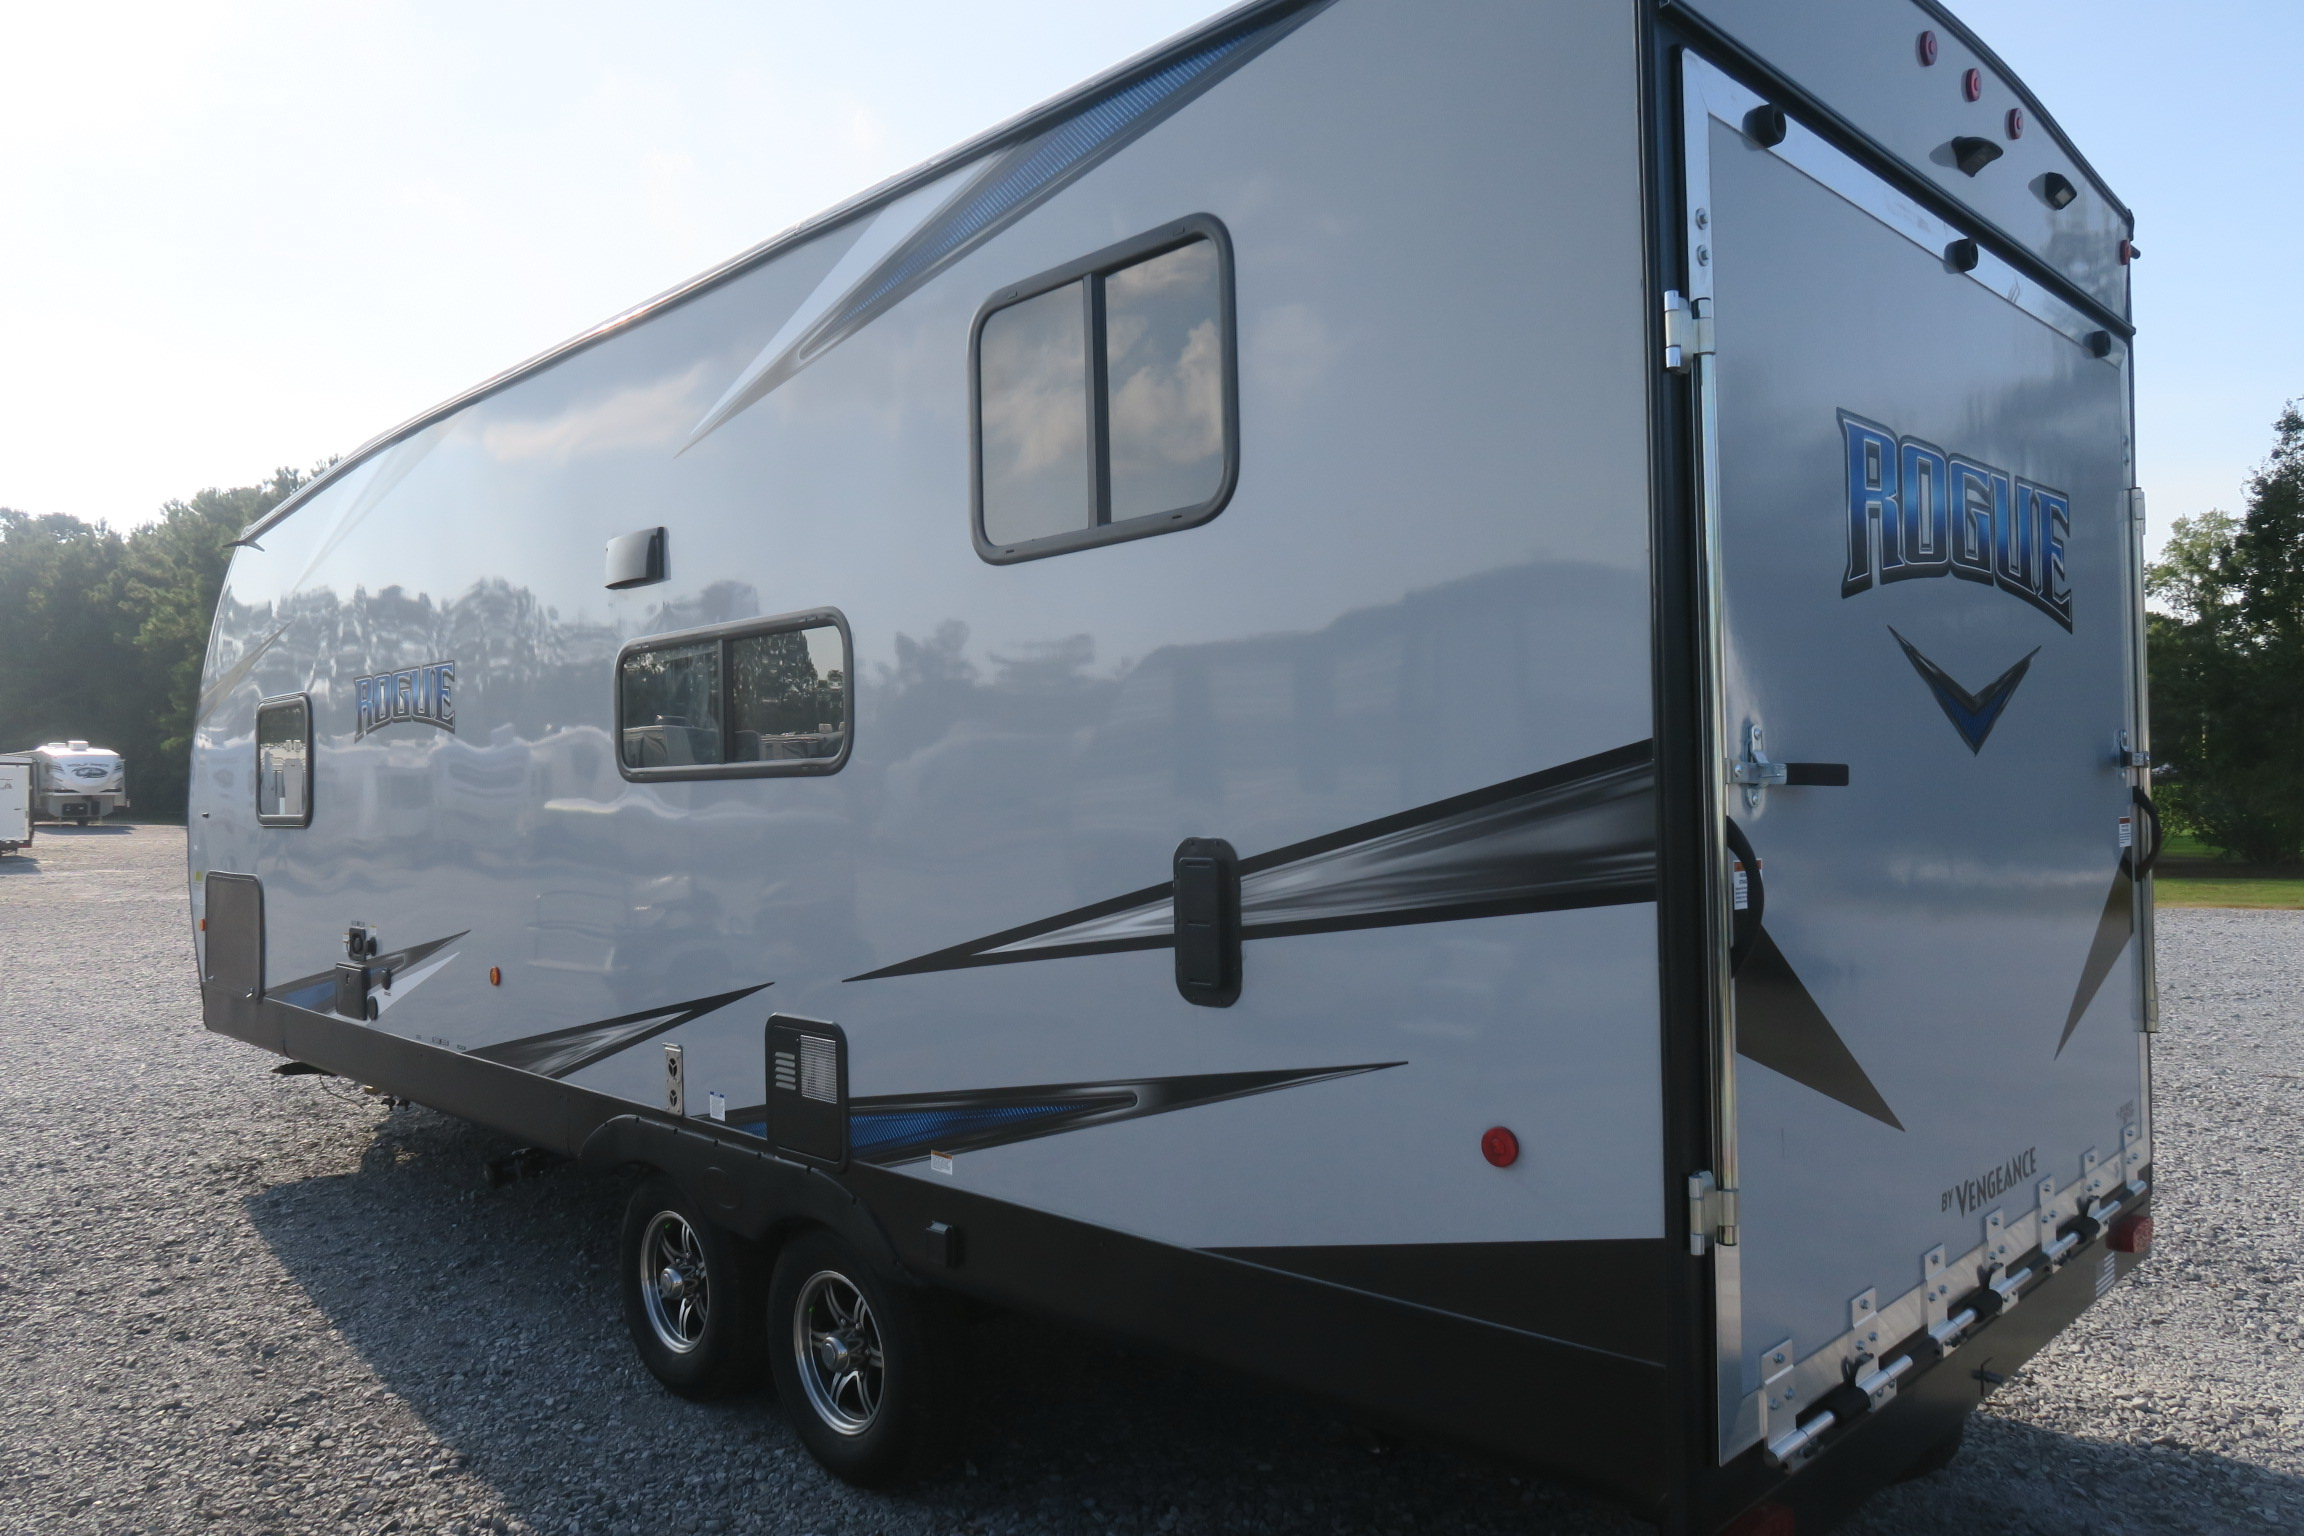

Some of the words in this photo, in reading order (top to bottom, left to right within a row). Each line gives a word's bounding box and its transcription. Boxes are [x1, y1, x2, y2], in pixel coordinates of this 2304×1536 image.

[1836, 406, 2073, 635] ROGUE
[354, 660, 455, 744] ROGUE
[1941, 1188, 1954, 1213] BY
[1955, 1146, 2037, 1219] VENGEANCE
